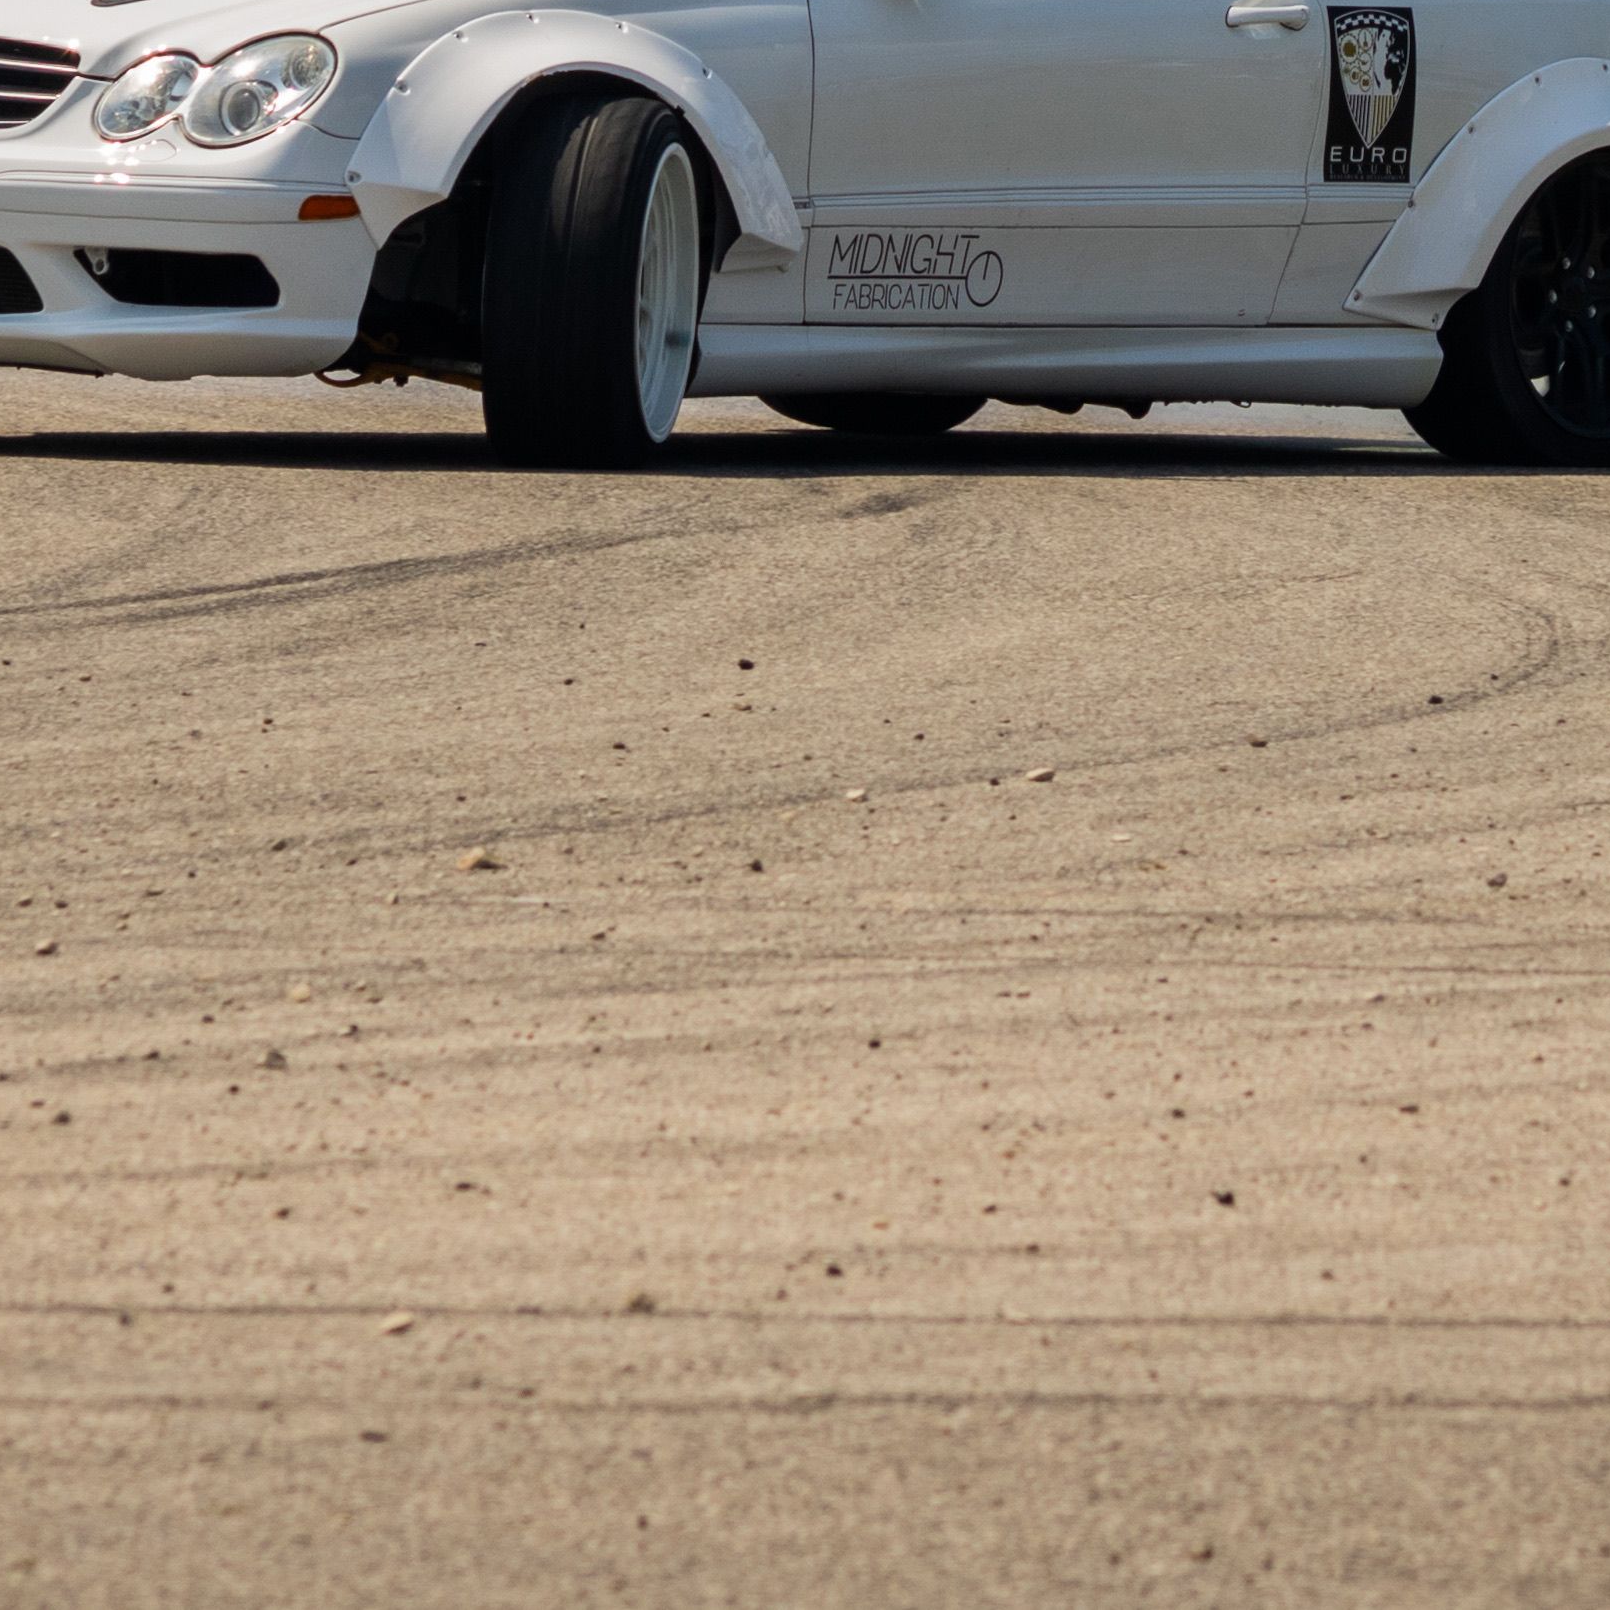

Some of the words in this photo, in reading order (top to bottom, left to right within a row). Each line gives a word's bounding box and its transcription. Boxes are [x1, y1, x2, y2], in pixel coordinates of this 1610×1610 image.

[1330, 146, 1407, 163] EURO
[1330, 163, 1405, 175] LUXURY
[828, 234, 980, 275] MIDNIGHT
[833, 284, 959, 310] FABRICATION
